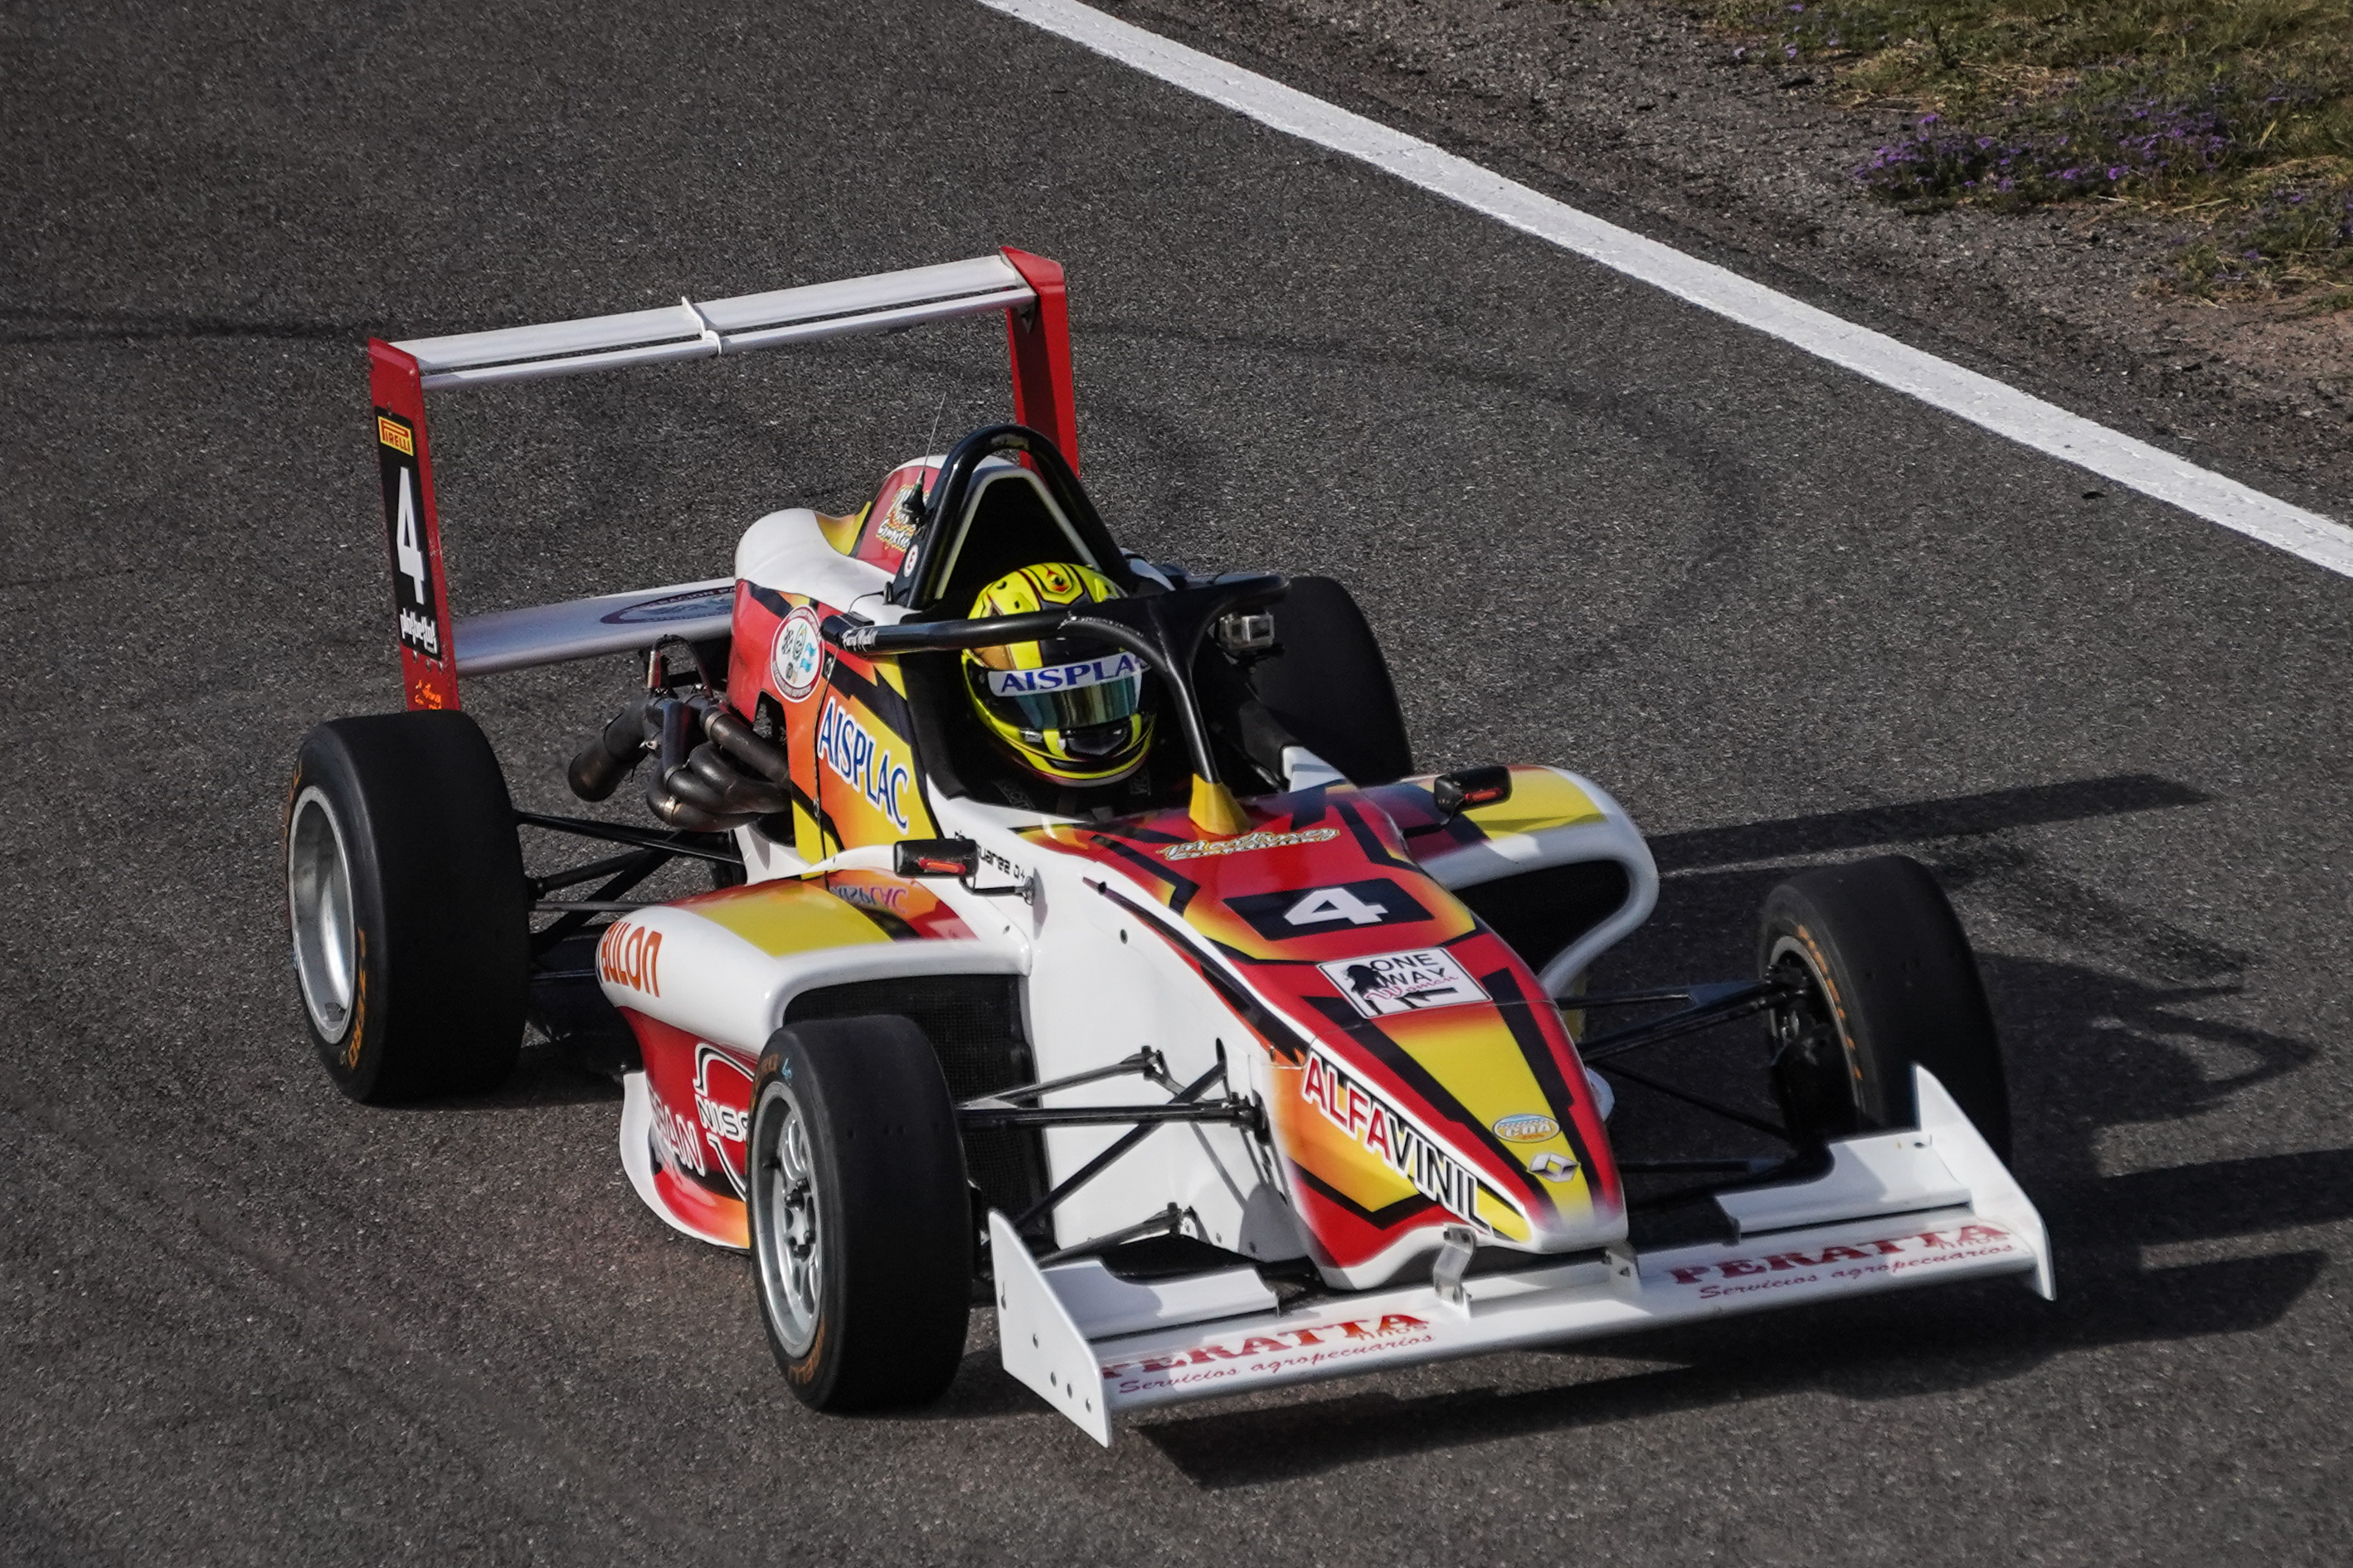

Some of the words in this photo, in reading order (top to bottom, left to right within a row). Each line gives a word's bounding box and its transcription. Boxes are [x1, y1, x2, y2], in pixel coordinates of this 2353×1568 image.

[380, 420, 411, 452] PIRELLI
[397, 467, 425, 605] 4
[818, 697, 911, 832] AISPLAC
[1285, 886, 1389, 925] 4
[1364, 975, 1459, 1001] Woman
[1371, 954, 1439, 972] ONE
[1378, 967, 1446, 985] WAY
[1303, 1050, 1493, 1236] ALFAVINIL
[1670, 1224, 2011, 1285] PERATTA
[1699, 1273, 1819, 1299] Servicios
[1830, 1242, 2015, 1280] agropecuarios
[1119, 1367, 1241, 1395] Servicios
[1250, 1332, 1437, 1374] agropecuarios
